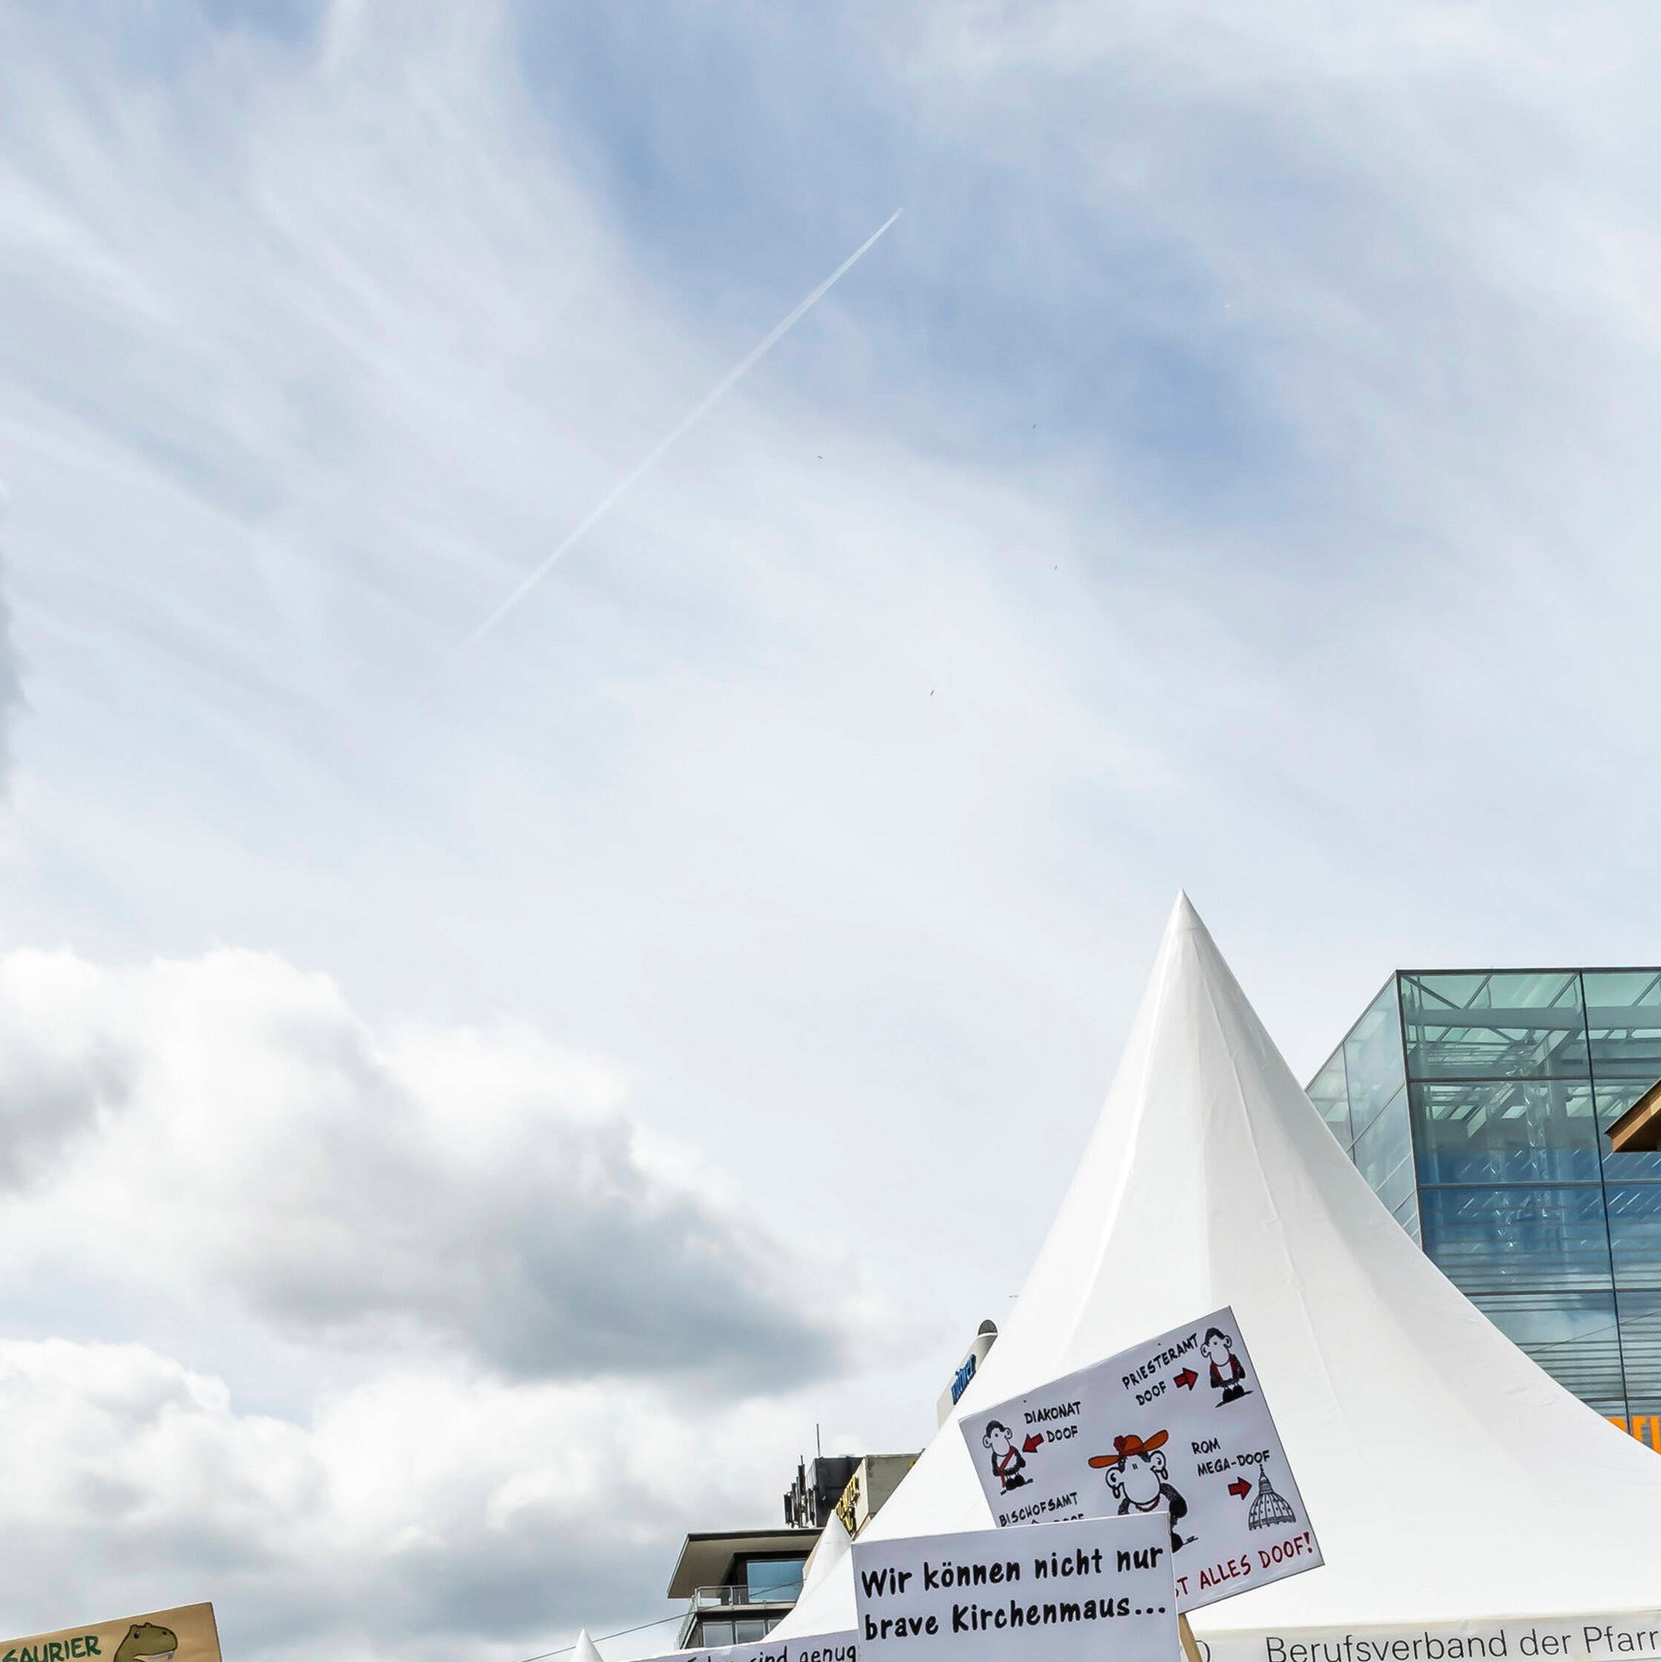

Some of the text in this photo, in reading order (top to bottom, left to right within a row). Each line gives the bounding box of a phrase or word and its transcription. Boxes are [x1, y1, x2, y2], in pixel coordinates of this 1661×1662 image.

[1122, 1333, 1198, 1390] PRIESTERAMT
[1136, 1381, 1166, 1406] DOOF
[1024, 1401, 1081, 1424] DIAKONAT
[1046, 1425, 1078, 1442] DOOF
[1191, 1438, 1221, 1454] ROM
[1197, 1450, 1270, 1476] MEGA-DOOF
[999, 1492, 1078, 1527] BISCHOFSAMT
[861, 1547, 1164, 1599] Wir können nicht nur
[1200, 1554, 1251, 1590] ALLES
[1258, 1531, 1313, 1569] DOOF!
[865, 1598, 1166, 1641] brave Kirchenmaus...
[1520, 1627, 1571, 1657] der
